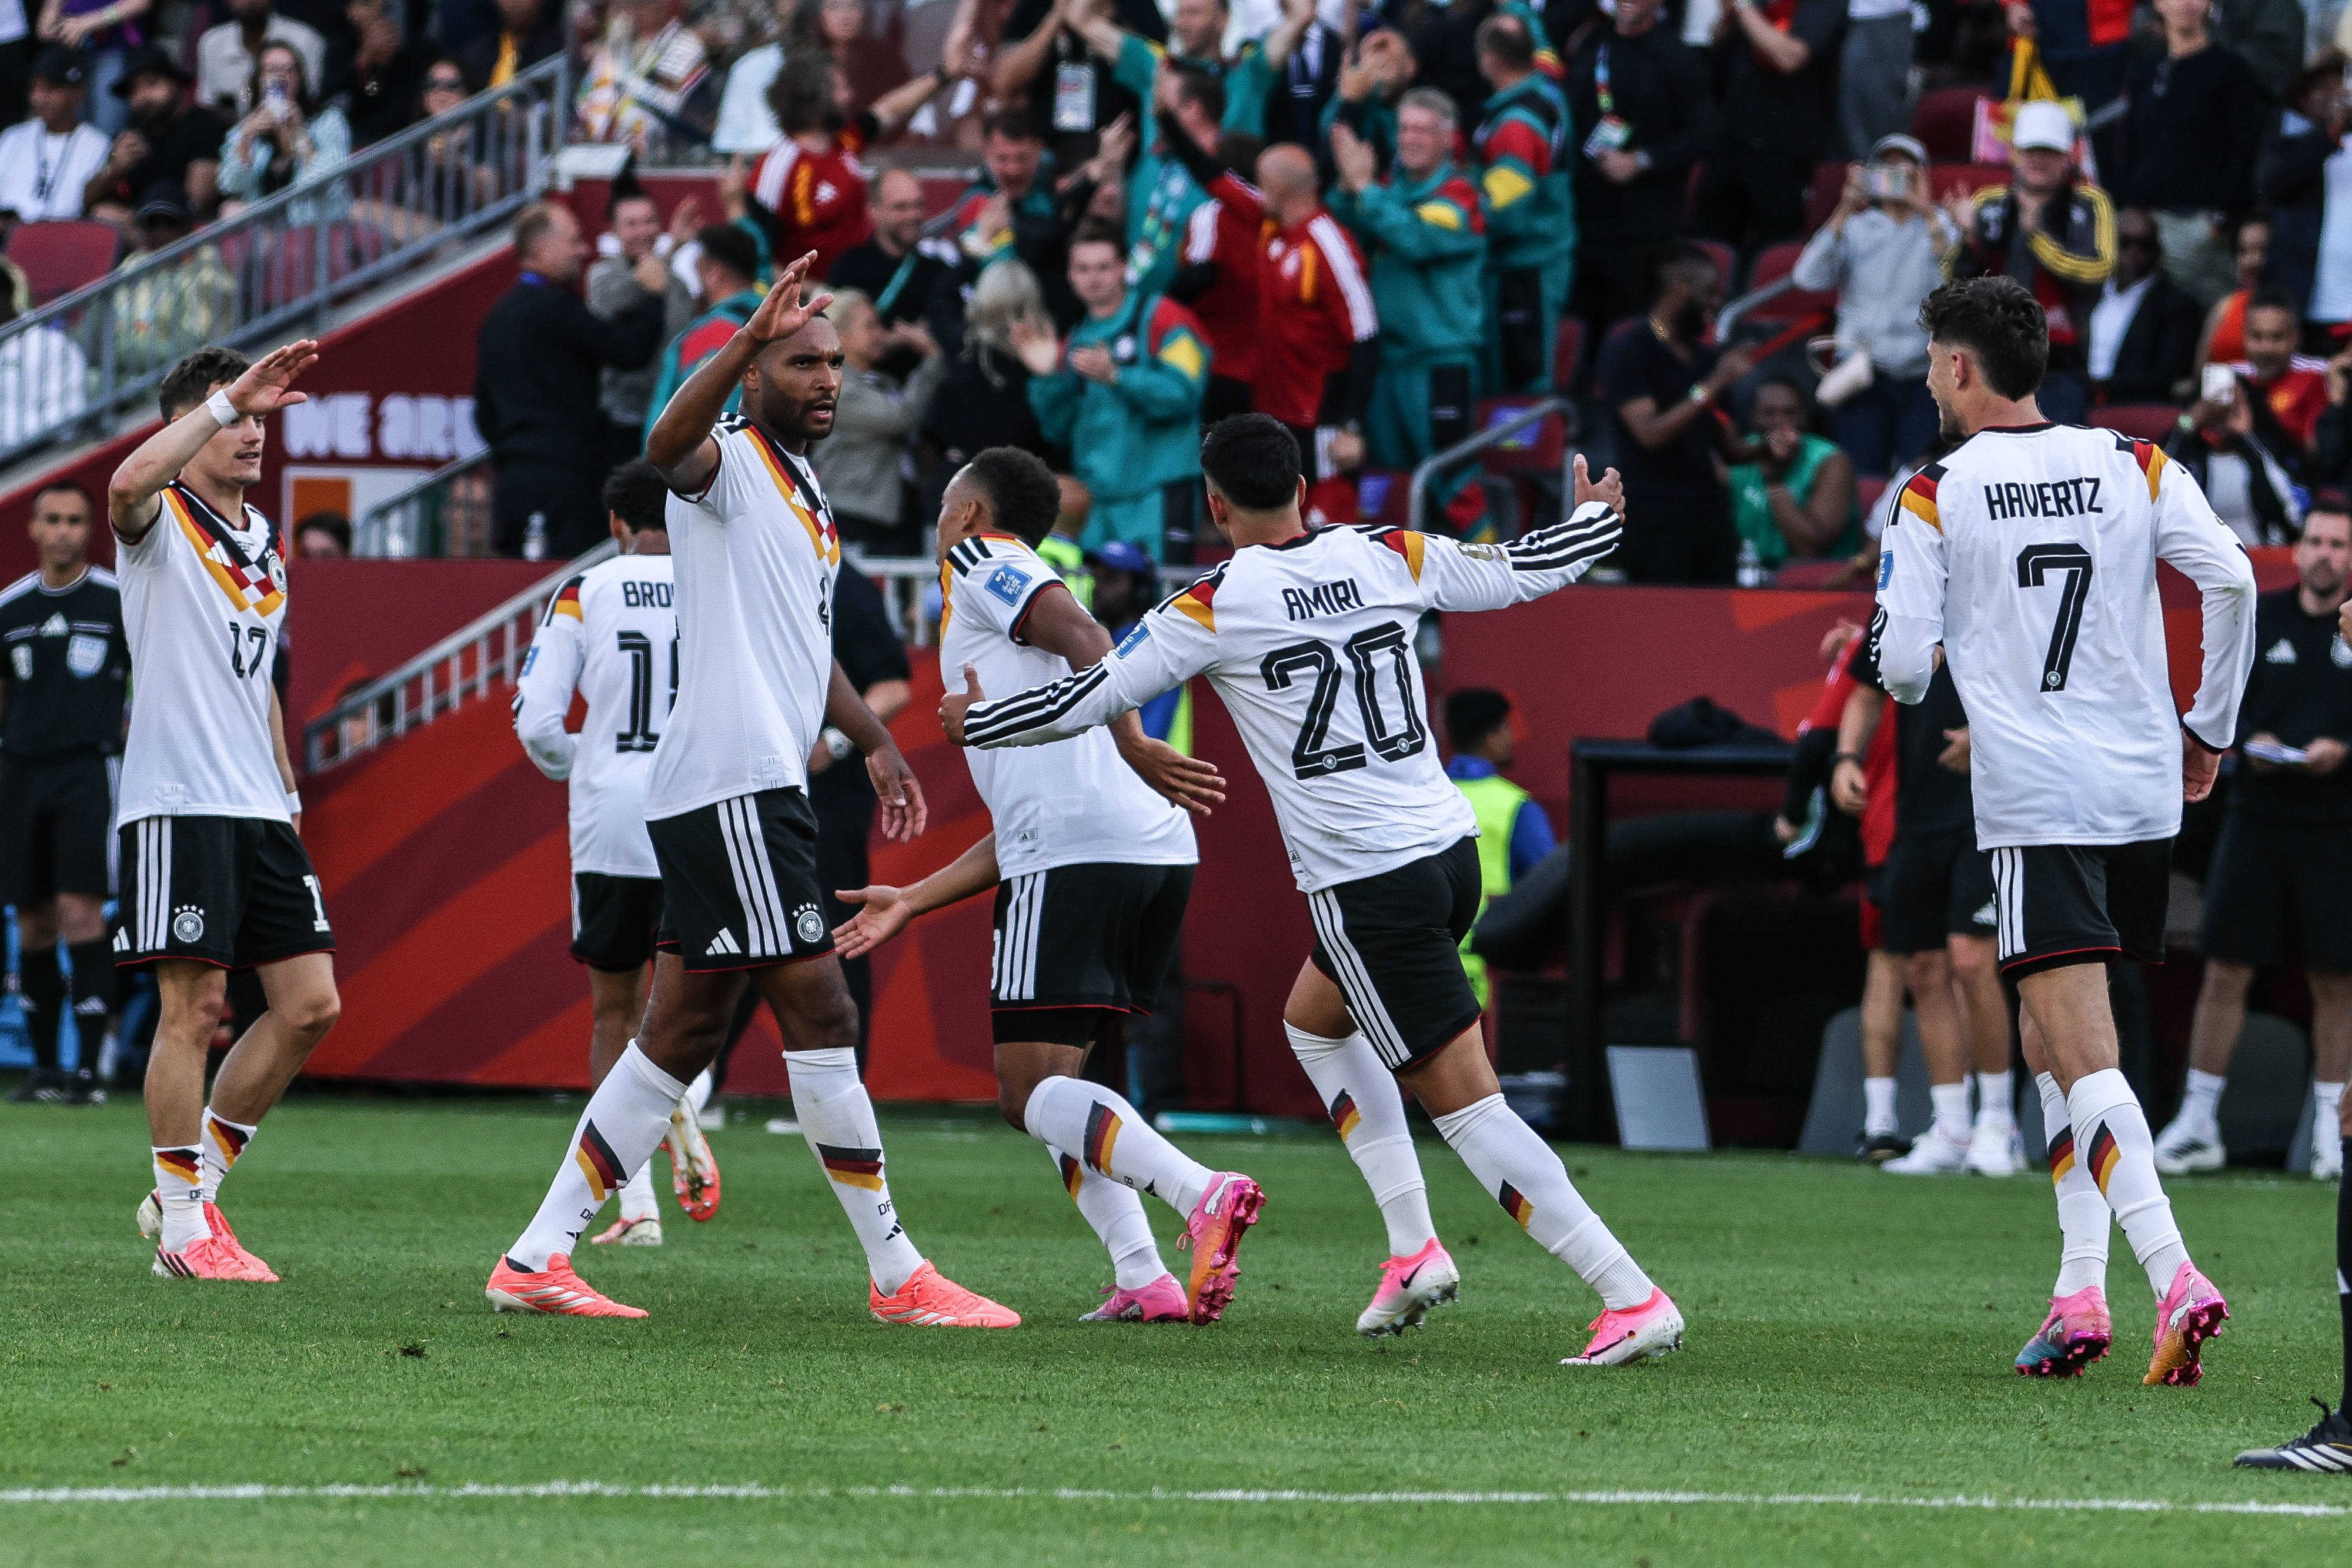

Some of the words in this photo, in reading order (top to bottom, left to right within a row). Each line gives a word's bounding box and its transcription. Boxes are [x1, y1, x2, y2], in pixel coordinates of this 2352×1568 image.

[1984, 477, 2103, 521] HAVERTZ
[622, 580, 674, 608] BRO
[1281, 578, 1366, 621] AMIRI
[2016, 542, 2093, 693] 7
[229, 621, 266, 679] 17
[1259, 620, 1426, 781] 20
[302, 874, 331, 933] 1
